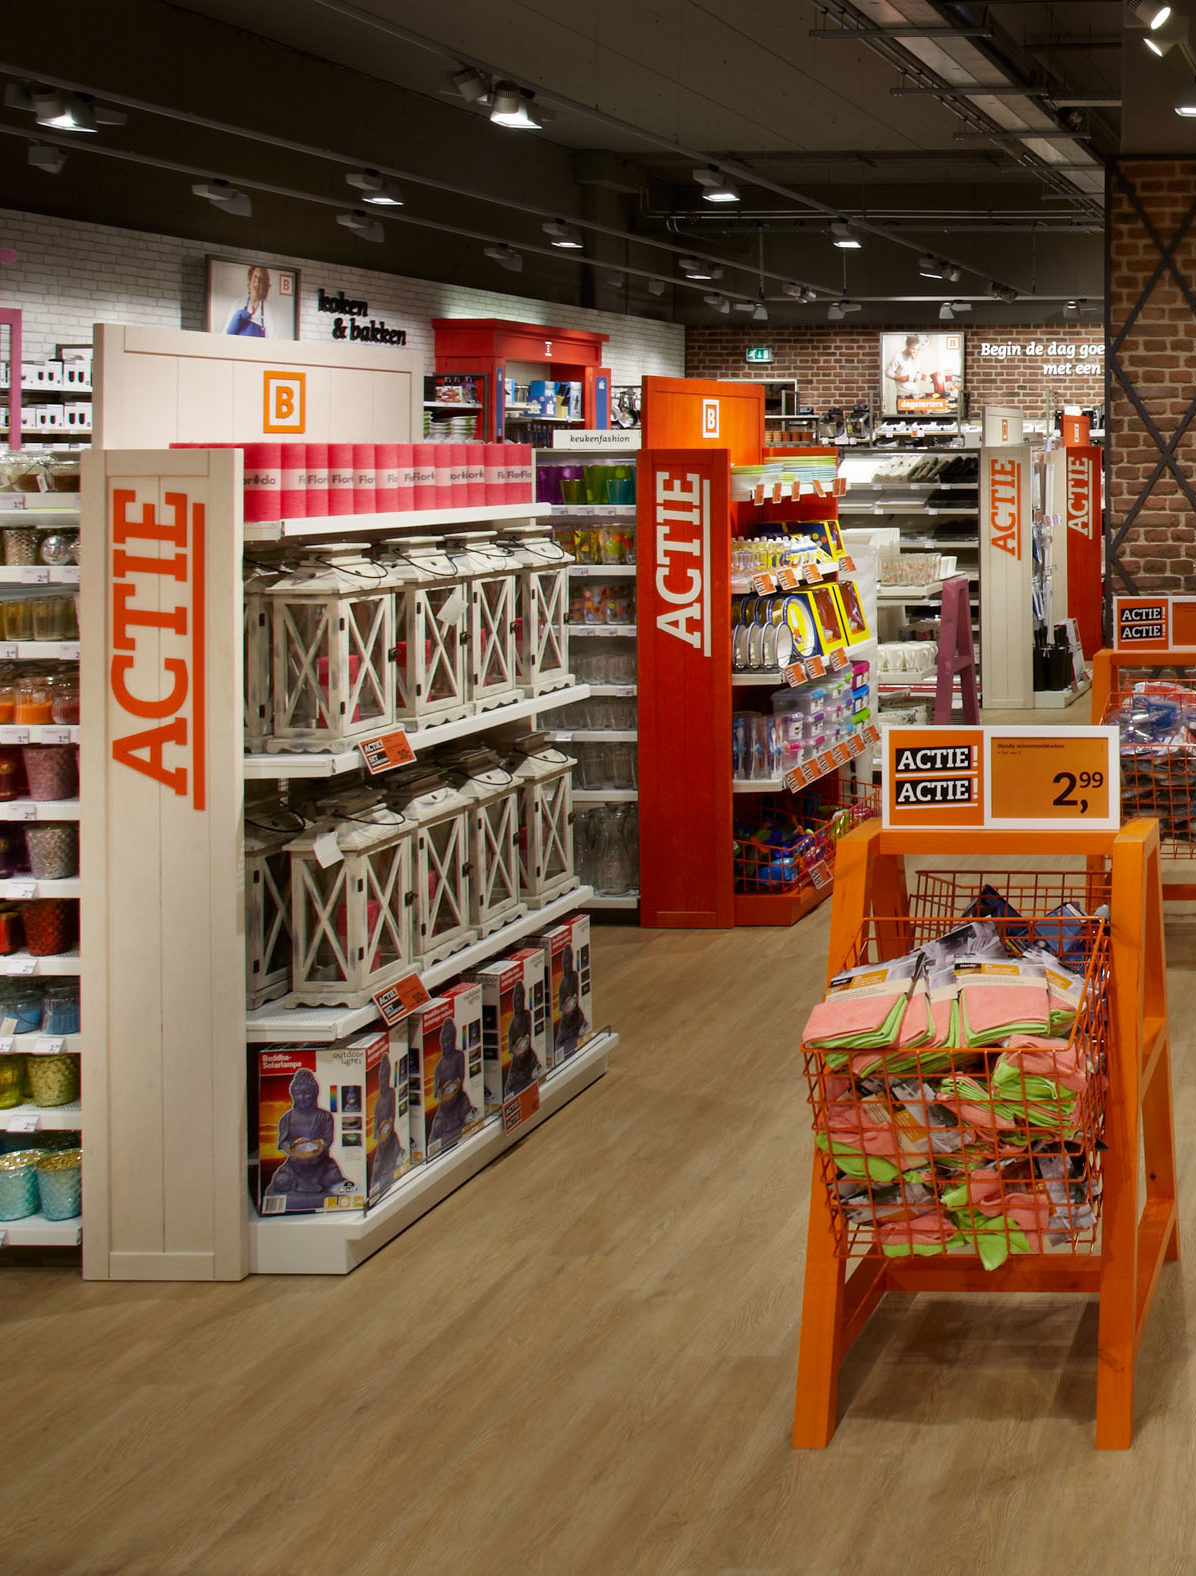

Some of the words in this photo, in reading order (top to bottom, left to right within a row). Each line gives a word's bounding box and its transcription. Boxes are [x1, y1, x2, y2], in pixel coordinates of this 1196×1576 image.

[318, 288, 368, 317] koken
[332, 318, 346, 339] &
[350, 318, 407, 346] bakken
[981, 342, 1022, 359] Begin
[1026, 342, 1043, 356] de
[1047, 341, 1076, 359] dag
[1080, 345, 1105, 359] goe
[1043, 364, 1072, 375] met
[1075, 366, 1101, 375] een
[276, 386, 294, 419] B
[707, 408, 715, 429] B
[570, 435, 630, 444] keukenfashion
[991, 459, 1017, 556] ACTIE
[1067, 457, 1089, 536] ACTIE
[655, 471, 701, 648] ACTIE
[1121, 607, 1166, 621] ACTIE!
[111, 489, 189, 796] ACTIE
[1121, 623, 1166, 638] ACTIE!
[897, 745, 978, 770] ACTIE!
[897, 777, 978, 802] ACTIE!
[1053, 771, 1104, 814] 2,99
[333, 1051, 364, 1059] outdoor
